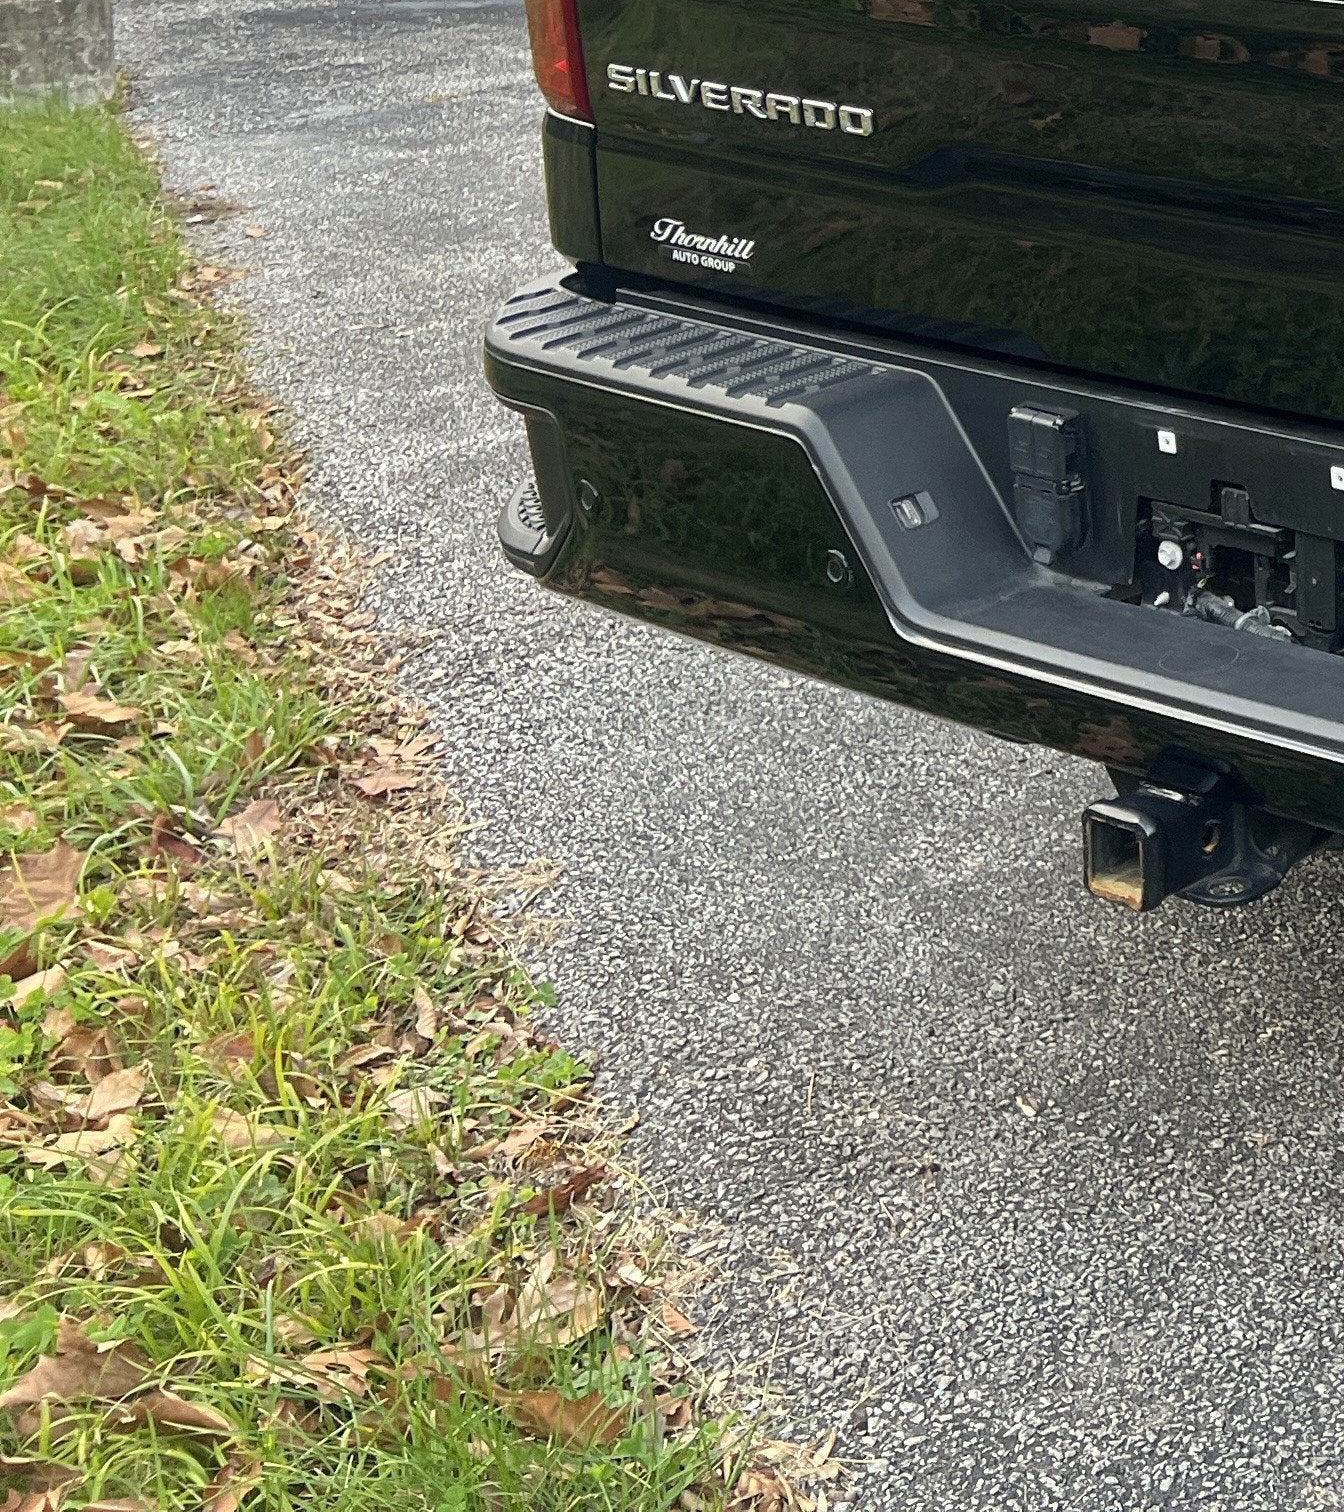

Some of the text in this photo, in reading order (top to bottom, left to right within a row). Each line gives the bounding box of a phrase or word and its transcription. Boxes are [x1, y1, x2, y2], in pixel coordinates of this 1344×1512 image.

[607, 63, 875, 138] SILVERADO
[650, 218, 756, 260] Thornhill
[672, 249, 736, 273] AUTO GROUP
